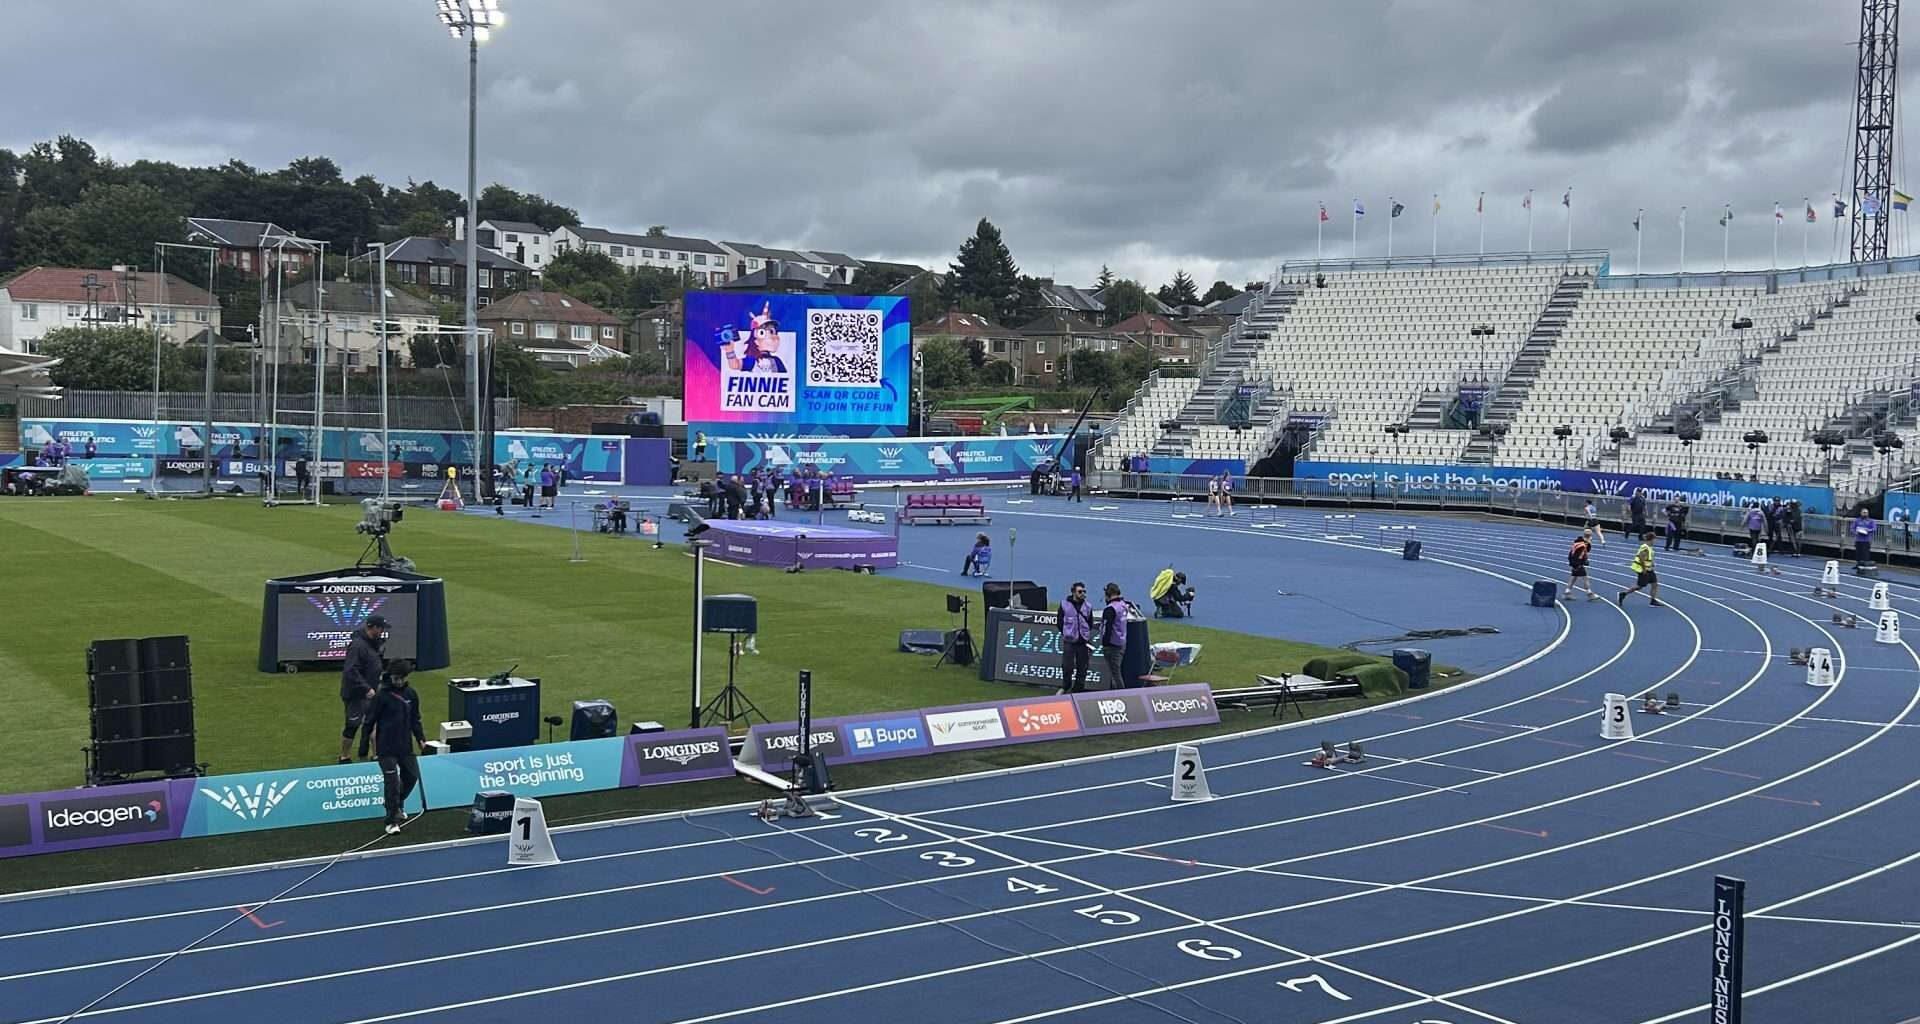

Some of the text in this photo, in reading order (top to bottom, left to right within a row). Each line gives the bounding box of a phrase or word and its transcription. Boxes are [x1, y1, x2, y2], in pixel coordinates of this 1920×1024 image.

[728, 377, 789, 393] FINNIE
[726, 394, 789, 408] FAN CAM
[803, 389, 880, 400] SCAN QR CODE
[808, 402, 894, 412] TO JOIN THE FUN
[1328, 472, 1377, 490] sport
[1384, 472, 1399, 487] is
[1404, 472, 1440, 493] just
[1445, 472, 1476, 491] the
[1757, 548, 1763, 556] 8
[1828, 566, 1832, 575] 7
[322, 585, 376, 594] LONGINES
[1874, 590, 1881, 600] 6
[1034, 615, 1058, 624] LONG
[1880, 620, 1888, 630] 5
[1894, 620, 1898, 631] 5
[1809, 658, 1815, 671] 4
[1821, 658, 1830, 672] 4
[1098, 699, 1126, 714] HBO
[1152, 698, 1200, 714] Ideagen
[482, 712, 520, 721] LONGINES
[1102, 712, 1129, 724] max
[1614, 706, 1624, 722] 3
[958, 716, 998, 728] commonwealth
[876, 728, 917, 743] Bupa
[642, 740, 720, 760] LONGINES
[484, 752, 574, 774] sport is just
[1181, 760, 1196, 780] 2
[306, 774, 384, 790] commonwe
[480, 767, 584, 788] the beginning
[335, 783, 380, 799] games
[322, 797, 385, 810] GLASGOW 20
[48, 805, 142, 828] Ideagen
[516, 816, 531, 840] 1
[854, 828, 908, 843] 2
[920, 850, 976, 868] 3
[1006, 876, 1059, 895] 4
[1073, 904, 1142, 926] 5
[1176, 938, 1243, 962] 6
[1714, 898, 1732, 1024] LONGINES
[1276, 973, 1352, 1000] 7
